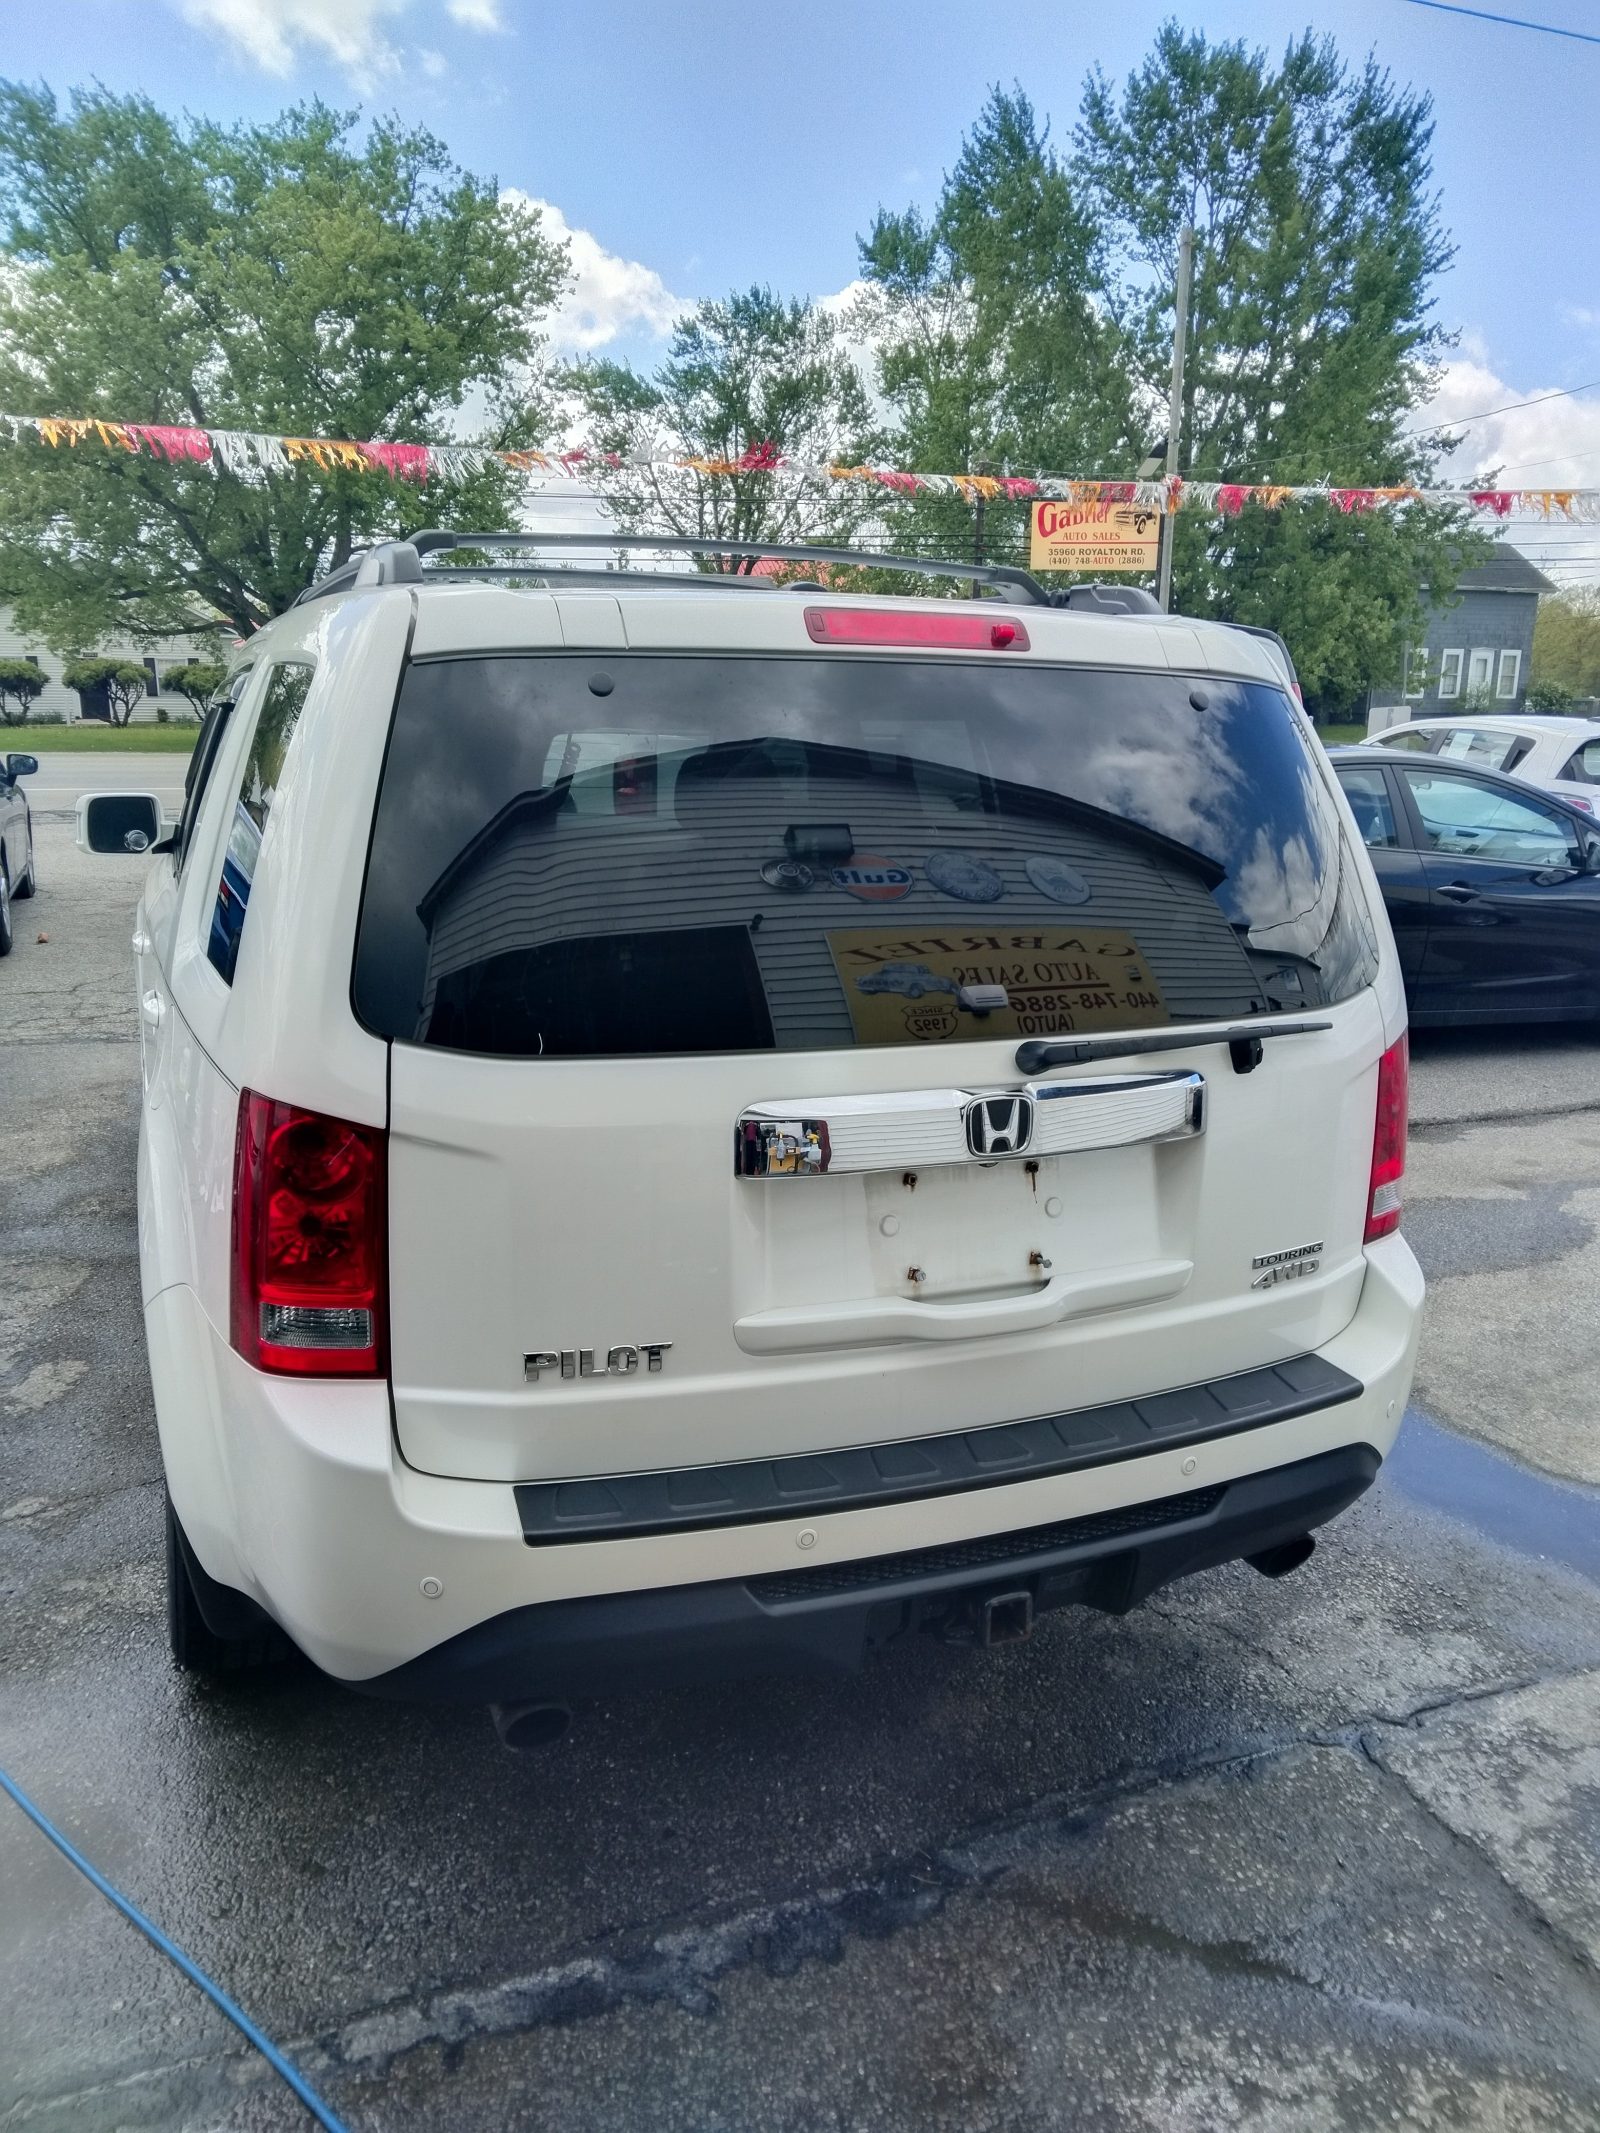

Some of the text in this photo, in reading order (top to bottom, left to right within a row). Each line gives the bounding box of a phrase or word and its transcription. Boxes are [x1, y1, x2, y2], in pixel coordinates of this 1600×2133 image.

[1062, 532, 1121, 541] AUTO SALES
[1048, 548, 1146, 556] 35960 ROYALTON RD.
[1048, 556, 1145, 565] (440) 748-AUTO (2886)
[1255, 1242, 1323, 1268] TOURING
[1251, 1258, 1320, 1290] 4WD
[523, 1341, 673, 1382] PILOT
